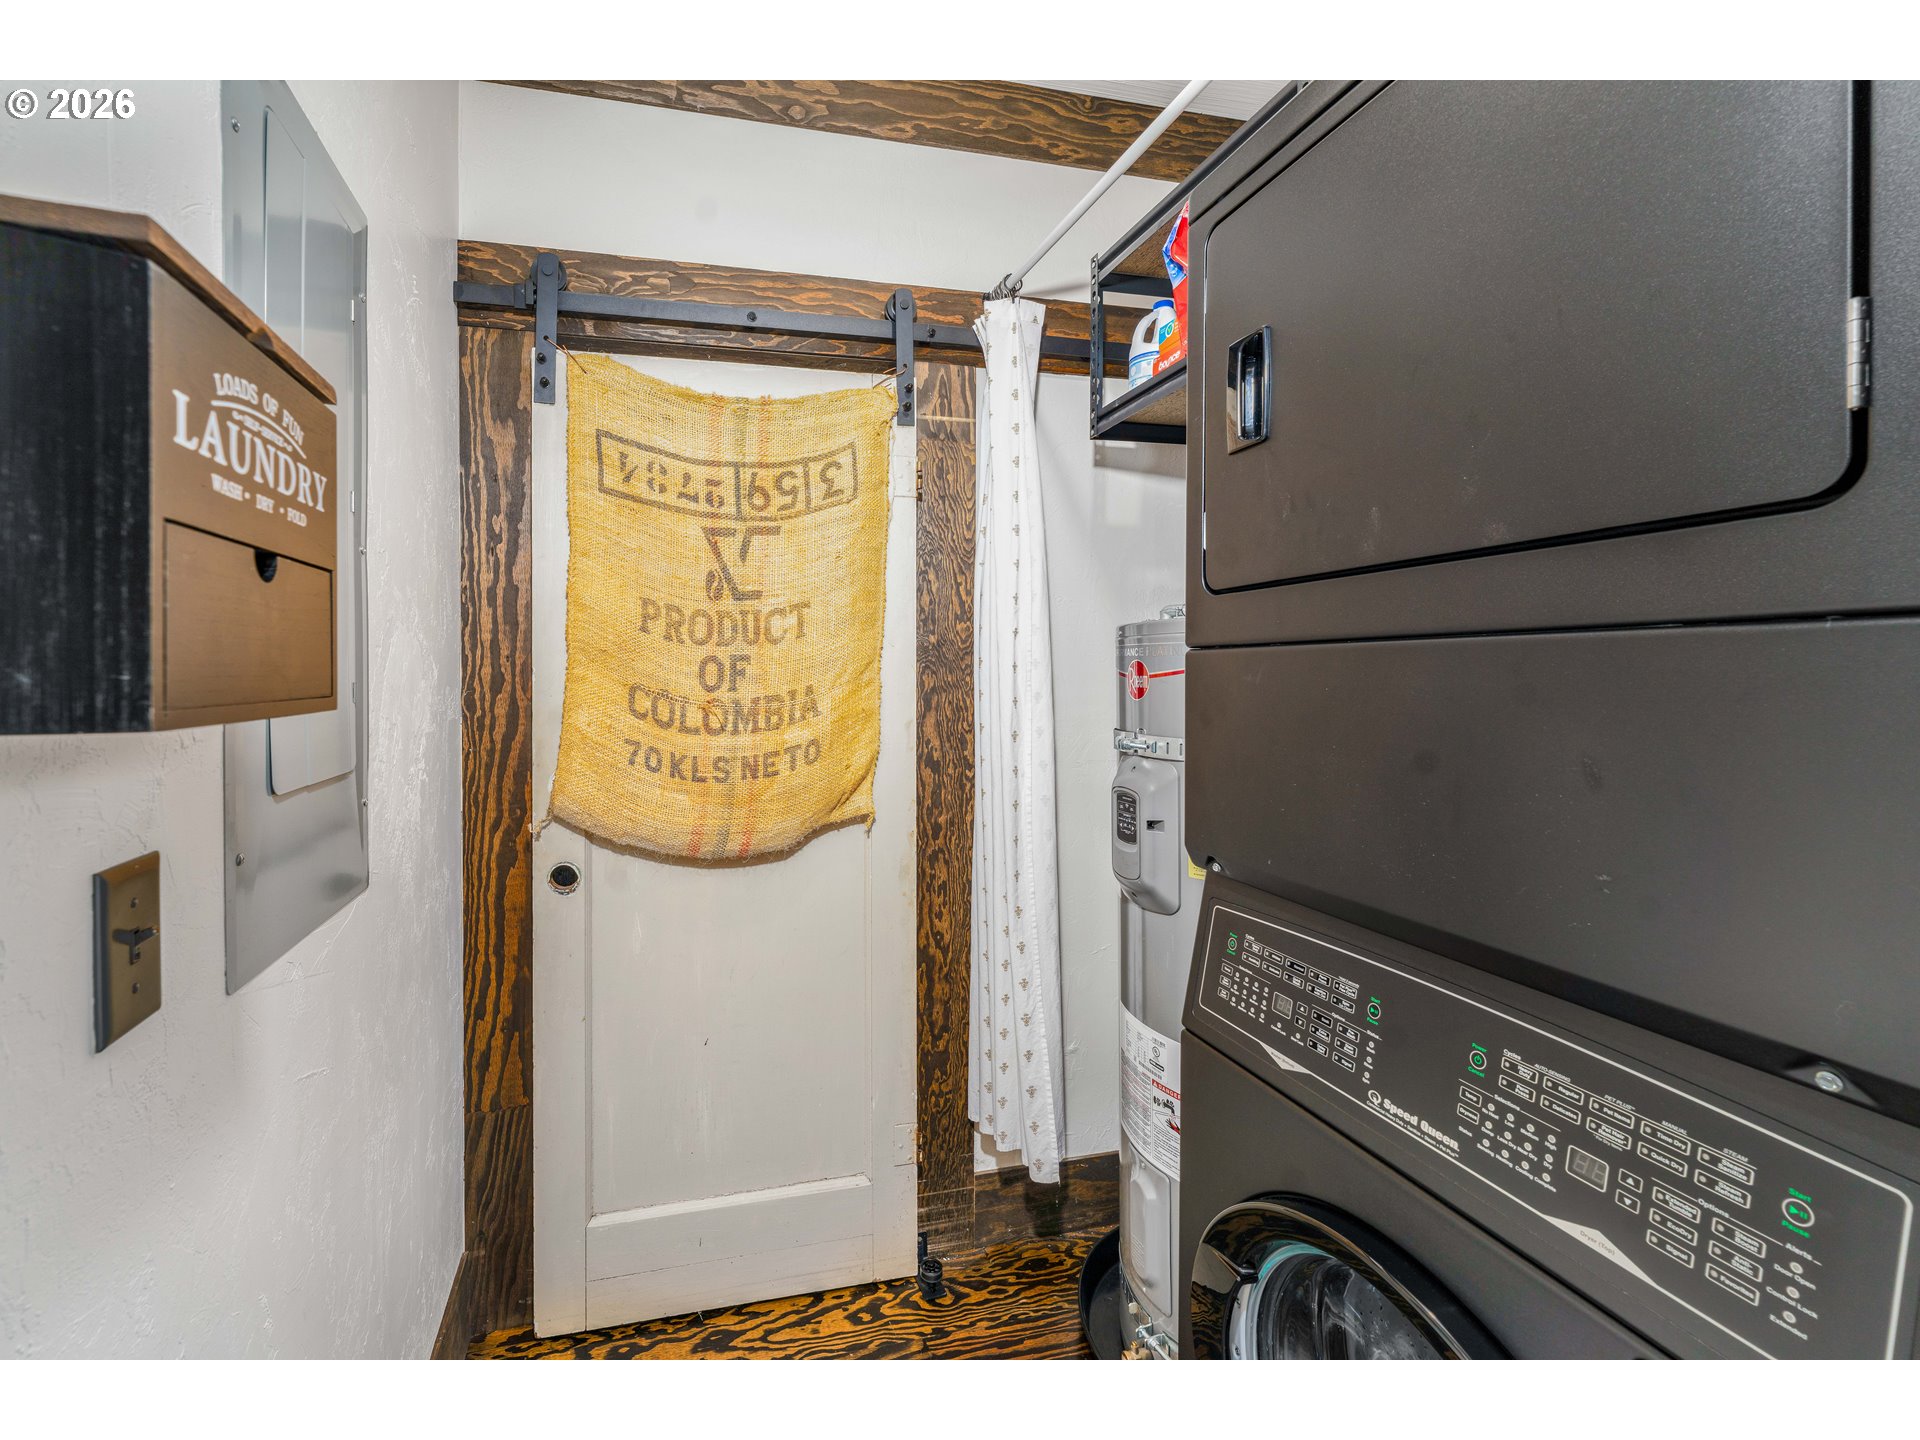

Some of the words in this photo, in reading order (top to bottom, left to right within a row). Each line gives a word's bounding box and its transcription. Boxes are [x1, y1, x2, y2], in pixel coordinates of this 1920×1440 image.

[213, 373, 259, 405] LOADS
[262, 393, 279, 417] OF
[282, 408, 305, 446] FUN
[171, 389, 327, 513] LAUNDRY
[819, 460, 845, 501] 3
[210, 472, 244, 501] WASH
[256, 493, 275, 514] DRY
[287, 507, 308, 527] FOLD
[640, 597, 811, 647] PRODUCT
[698, 654, 751, 693] OF
[628, 683, 822, 737] COLOMBIA
[741, 738, 821, 781] NETO
[1466, 1092, 1478, 1102] Temp
[1558, 1086, 1580, 1100] Regular
[1552, 1104, 1578, 1120] Delicates
[1383, 1098, 1419, 1126] Speed
[1420, 1120, 1458, 1150] Queen
[1661, 1120, 1688, 1136] MANUAL
[1657, 1132, 1672, 1144] Time
[1673, 1139, 1686, 1150] Dry
[1650, 1152, 1670, 1166] Quick
[1670, 1161, 1684, 1172] Dry
[1723, 1148, 1749, 1162] STEAM
[1544, 1161, 1552, 1170] Dry
[1718, 1162, 1748, 1181] Sanitize
[1722, 1160, 1746, 1174] Steam
[1714, 1186, 1744, 1204] Refresh
[1718, 1182, 1742, 1197] Steam
[1788, 1188, 1812, 1203] Start
[1665, 1194, 1696, 1214] Extended
[1698, 1198, 1730, 1218] Options
[1666, 1221, 1692, 1240] EcoDry
[1781, 1220, 1810, 1238] Pause
[1734, 1237, 1758, 1253] Boost
[1735, 1231, 1760, 1247] Steam
[1666, 1244, 1688, 1260] Signal
[1785, 1242, 1812, 1260] Alerts
[1731, 1260, 1754, 1276] Static
[1774, 1264, 1793, 1278] Door
[1794, 1274, 1816, 1290] Open
[1720, 1276, 1754, 1299] Favorites
[1766, 1286, 1796, 1307] Control
[1797, 1304, 1818, 1319] Lock
[1769, 1314, 1808, 1340] Extended
